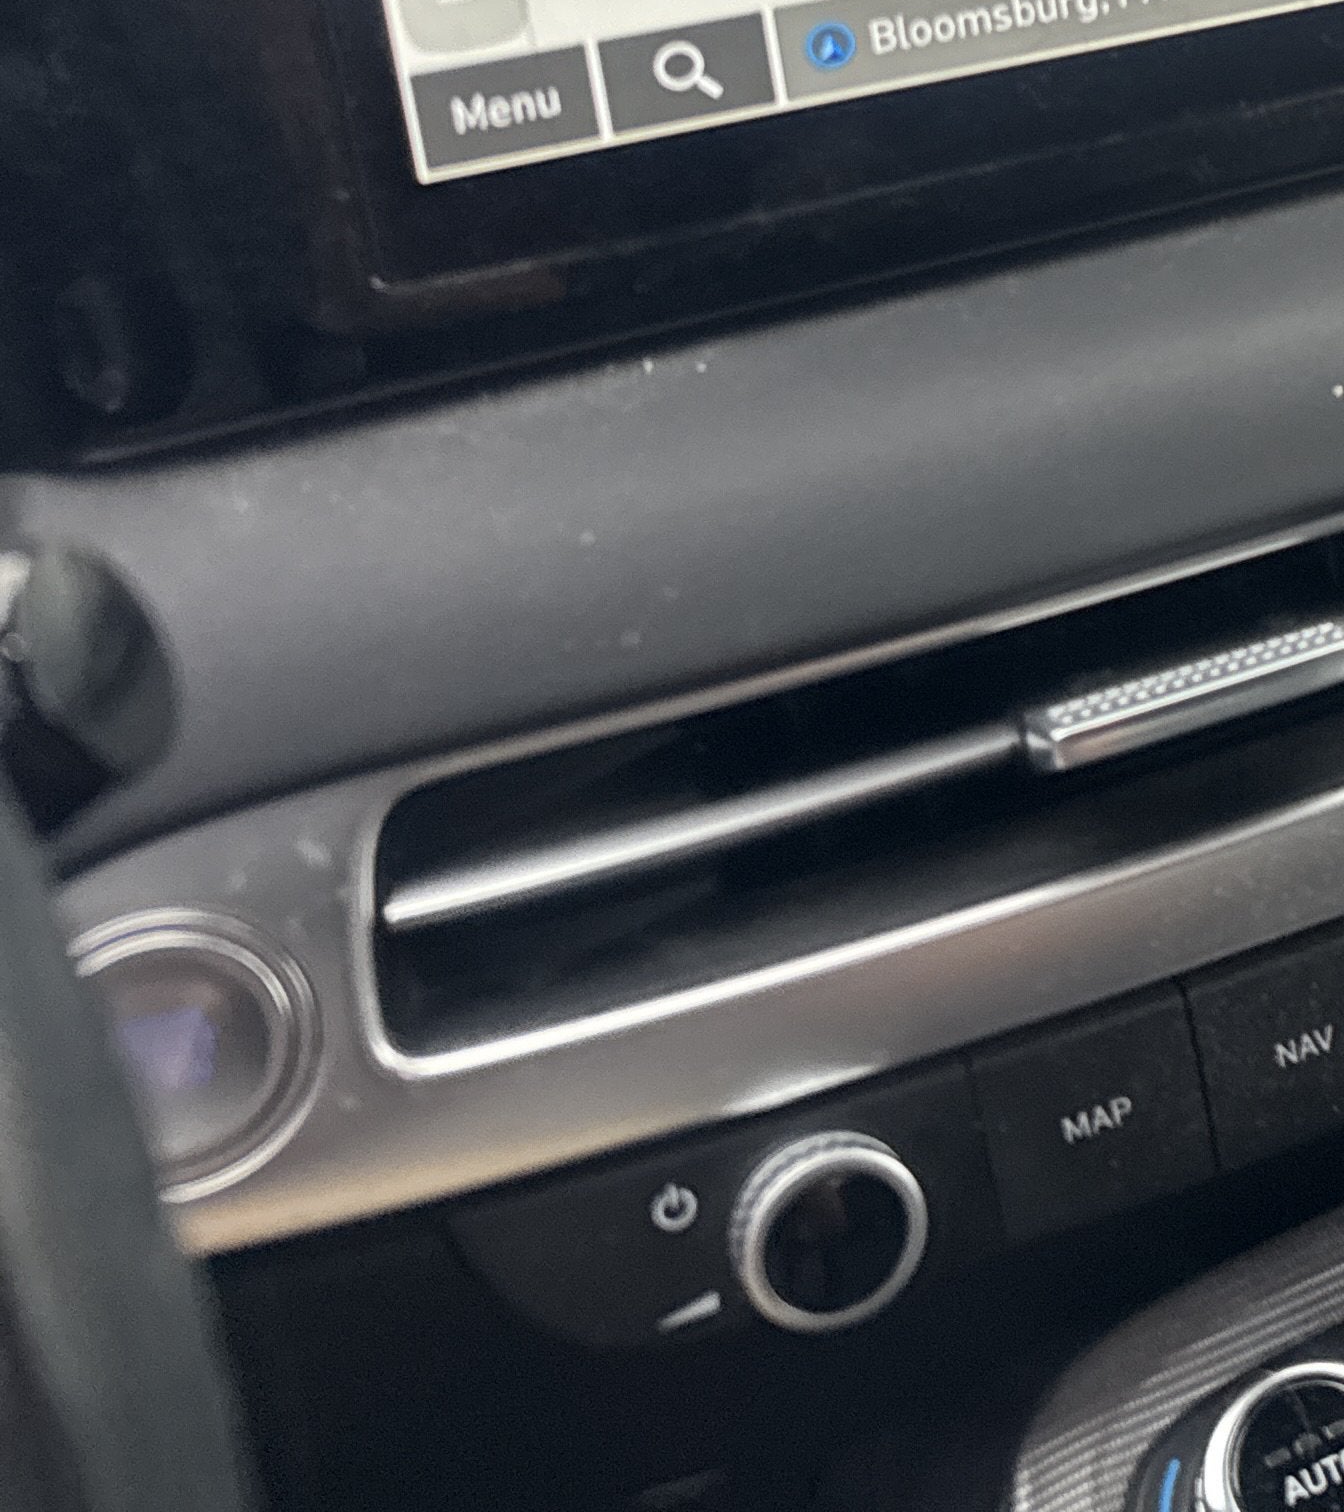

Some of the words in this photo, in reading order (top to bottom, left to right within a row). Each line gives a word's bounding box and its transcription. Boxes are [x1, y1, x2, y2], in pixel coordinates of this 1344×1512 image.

[450, 85, 562, 136] Menu
[1273, 1023, 1335, 1068] NAV
[1060, 1095, 1134, 1144] MAP
